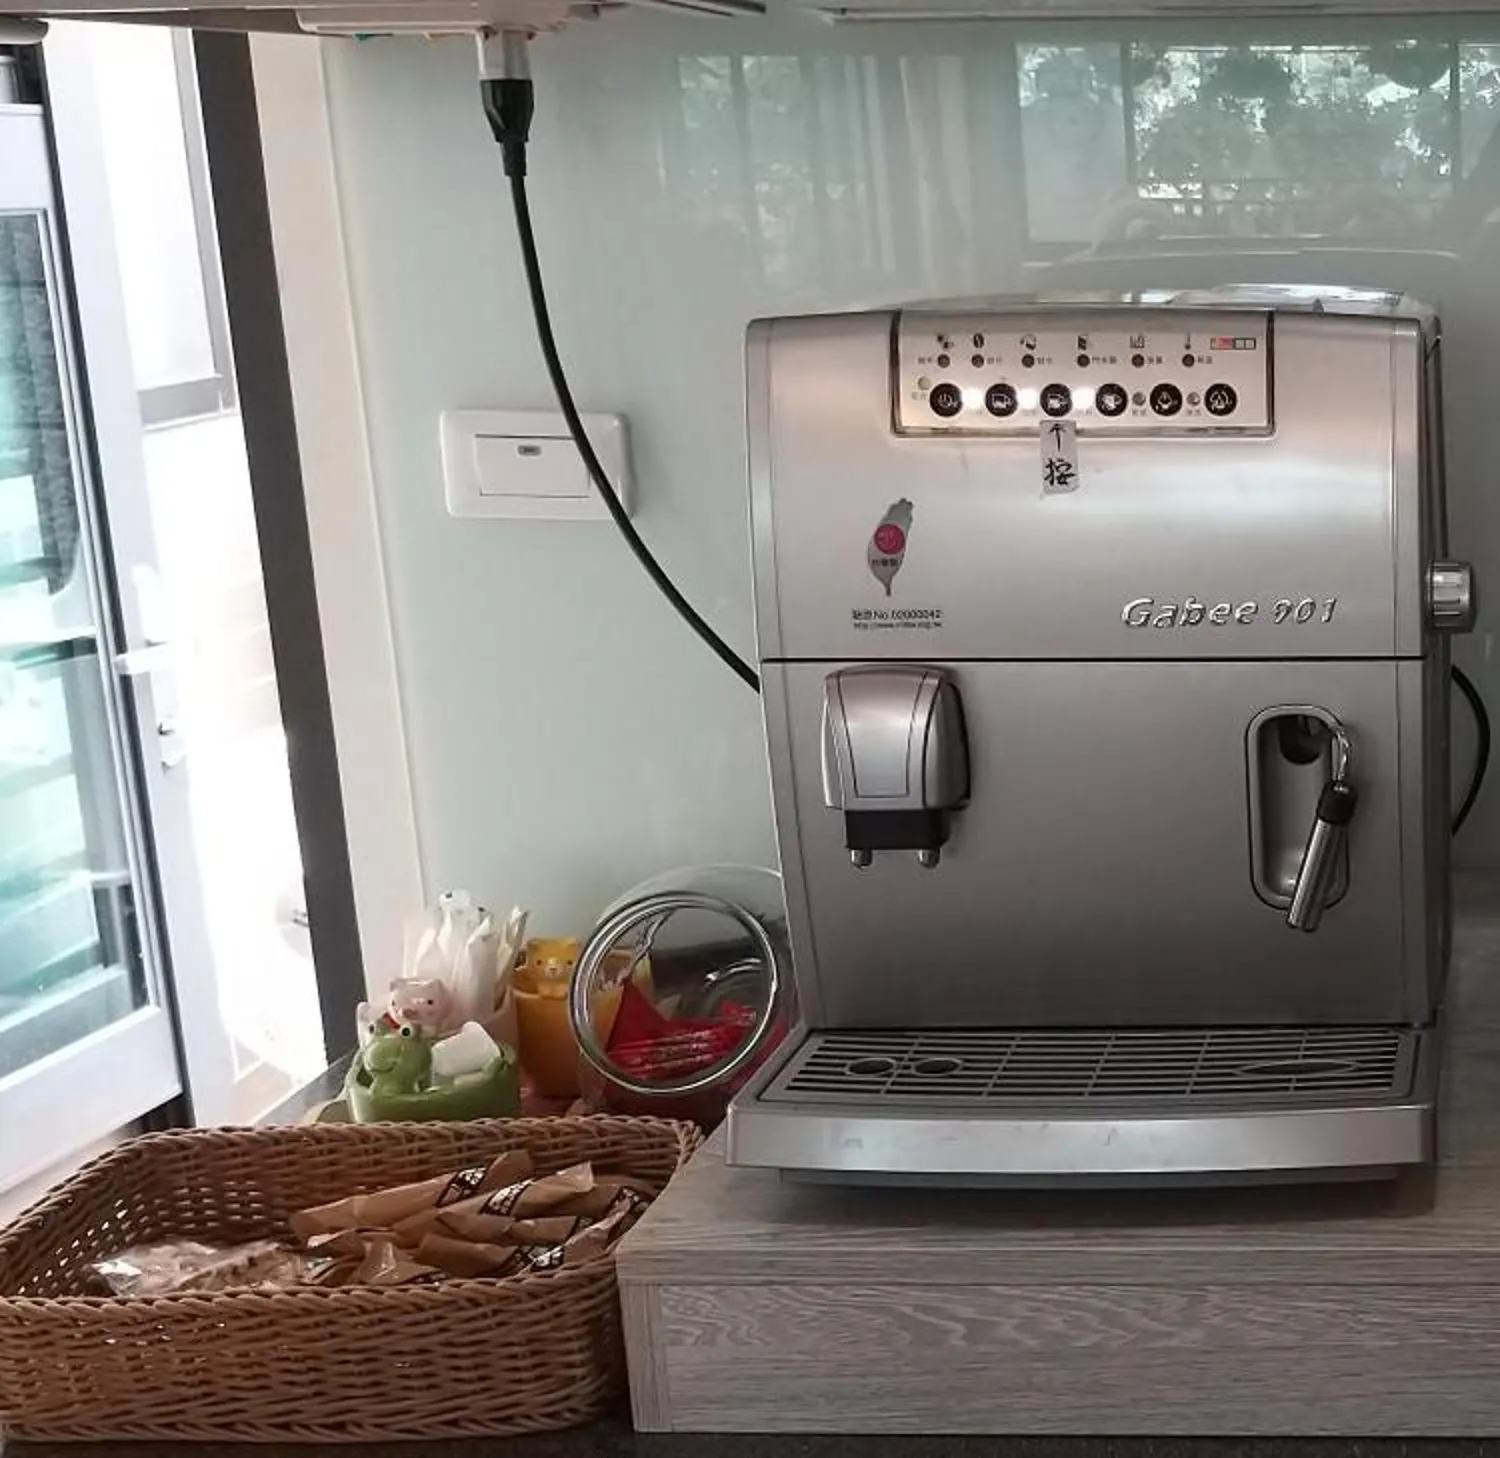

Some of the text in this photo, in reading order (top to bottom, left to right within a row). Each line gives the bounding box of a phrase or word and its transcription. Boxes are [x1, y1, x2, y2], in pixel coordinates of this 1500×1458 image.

[1044, 457, 1076, 486] 按
[1121, 596, 1338, 628] Gabee 901
